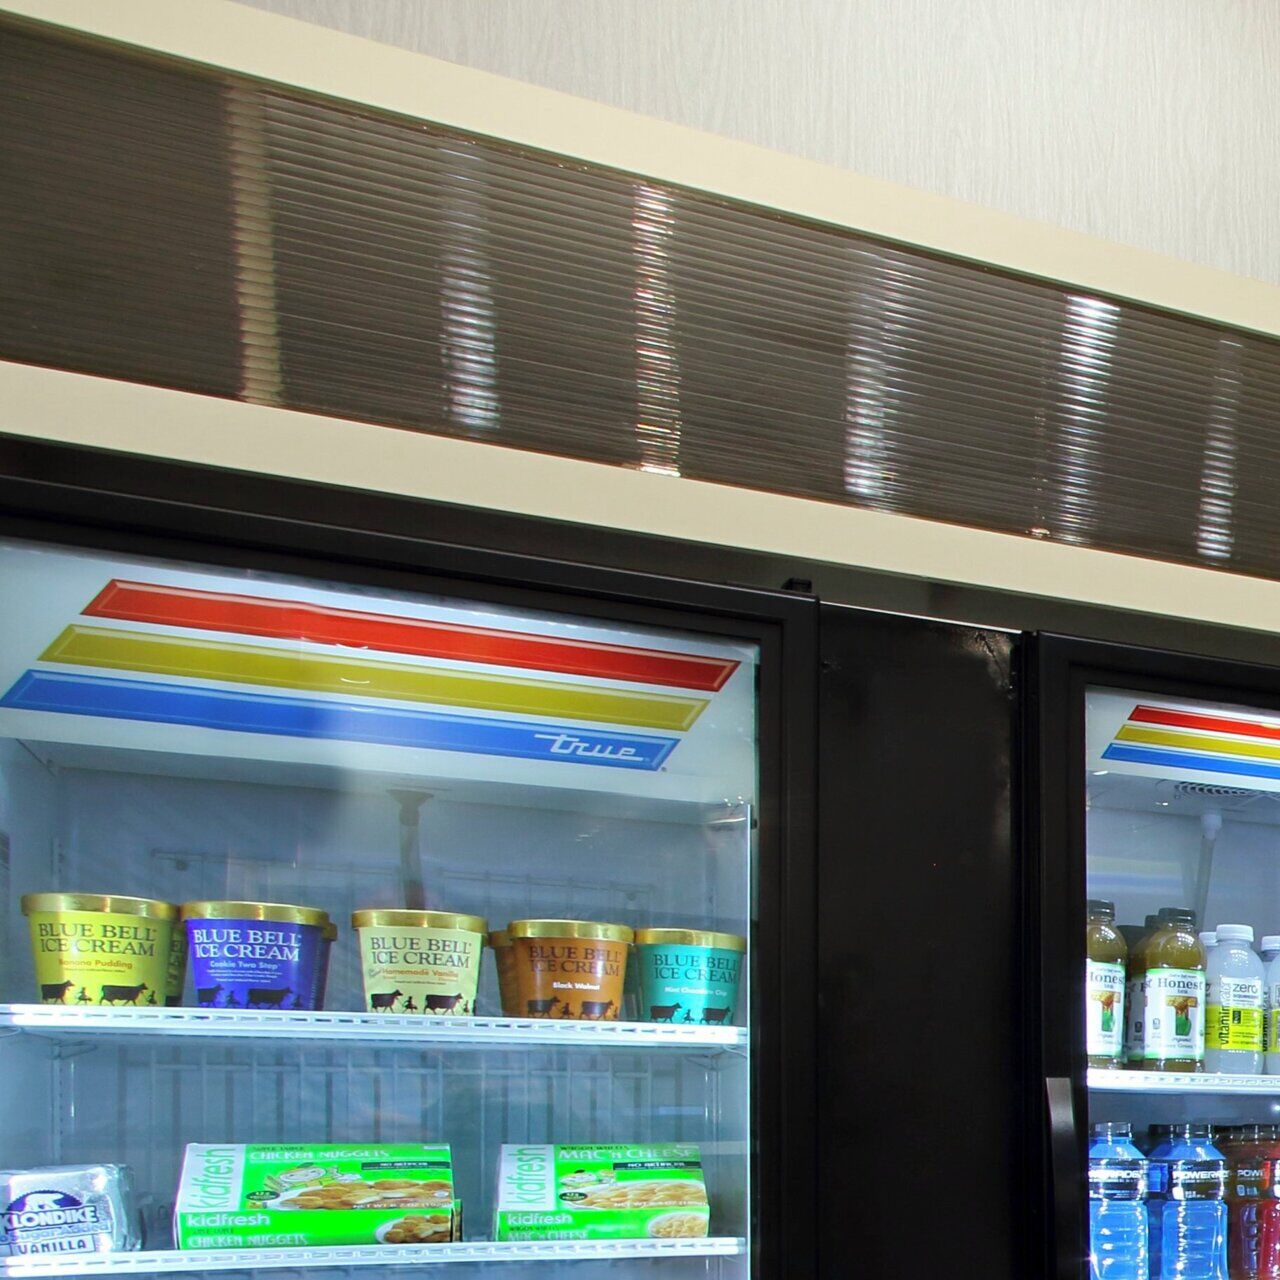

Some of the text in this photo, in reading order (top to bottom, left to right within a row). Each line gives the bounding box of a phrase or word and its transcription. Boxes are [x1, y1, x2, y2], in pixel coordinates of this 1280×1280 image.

[39, 923, 156, 942] BLUE BELL
[193, 928, 302, 948] BLUE BELL
[41, 938, 155, 956] ICE CREAM
[195, 944, 299, 962] ICE CREAM
[371, 937, 471, 954] BLUE BELL
[373, 951, 469, 968] ICE CREAM
[529, 946, 621, 964] BLUE BELL
[653, 954, 699, 968] BLUE
[58, 959, 133, 970] Banana Pudding
[210, 960, 236, 969] Cookie
[238, 961, 256, 969] Two
[531, 959, 619, 977] ICE CREAM
[655, 967, 680, 980] ICE
[552, 981, 573, 989] Black
[1232, 983, 1258, 993] zero
[249, 1150, 390, 1160] CHICKEN NUGGETS
[188, 1148, 236, 1210] kidfresh
[506, 1148, 546, 1205] kidfresh
[187, 1213, 271, 1227] kidfresh
[507, 1213, 573, 1225] kidfresh
[18, 1239, 86, 1254] VANILLA
